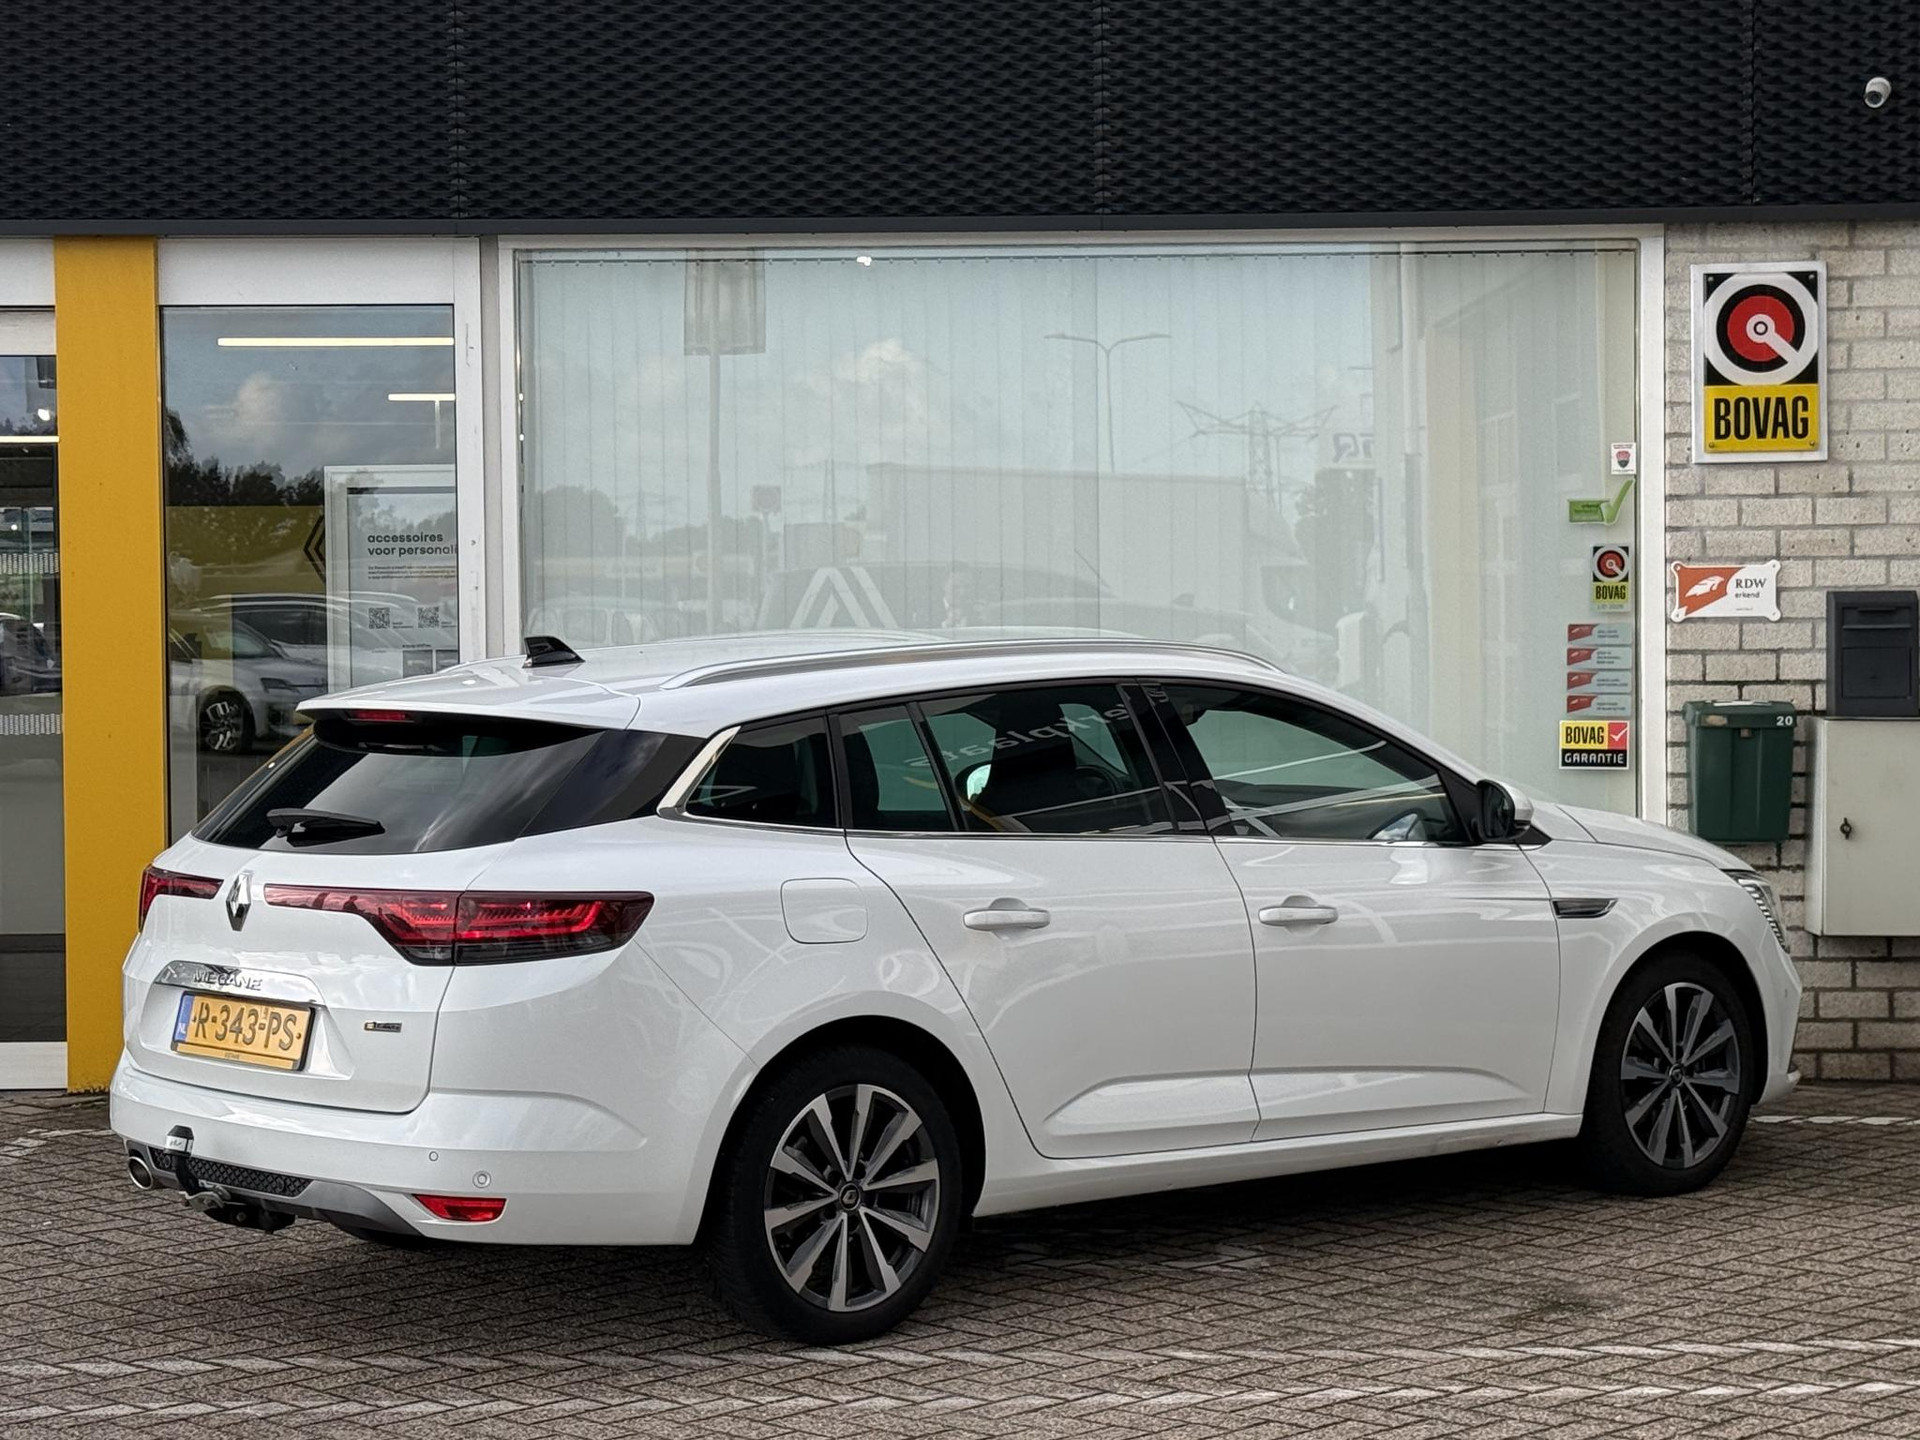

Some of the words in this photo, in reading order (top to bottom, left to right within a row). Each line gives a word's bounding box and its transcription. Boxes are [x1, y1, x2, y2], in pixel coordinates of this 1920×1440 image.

[1714, 396, 1809, 440] BOVAG
[367, 532, 444, 543] accessoires
[367, 547, 396, 555] voor
[1735, 578, 1767, 589] RDW
[1595, 585, 1626, 600] BOVAG
[1735, 591, 1760, 599] erkend
[1776, 715, 1794, 726] 20
[1565, 726, 1605, 744] BOVAG
[1564, 753, 1625, 764] GARANTIE
[192, 1001, 298, 1051] R-343-PS
